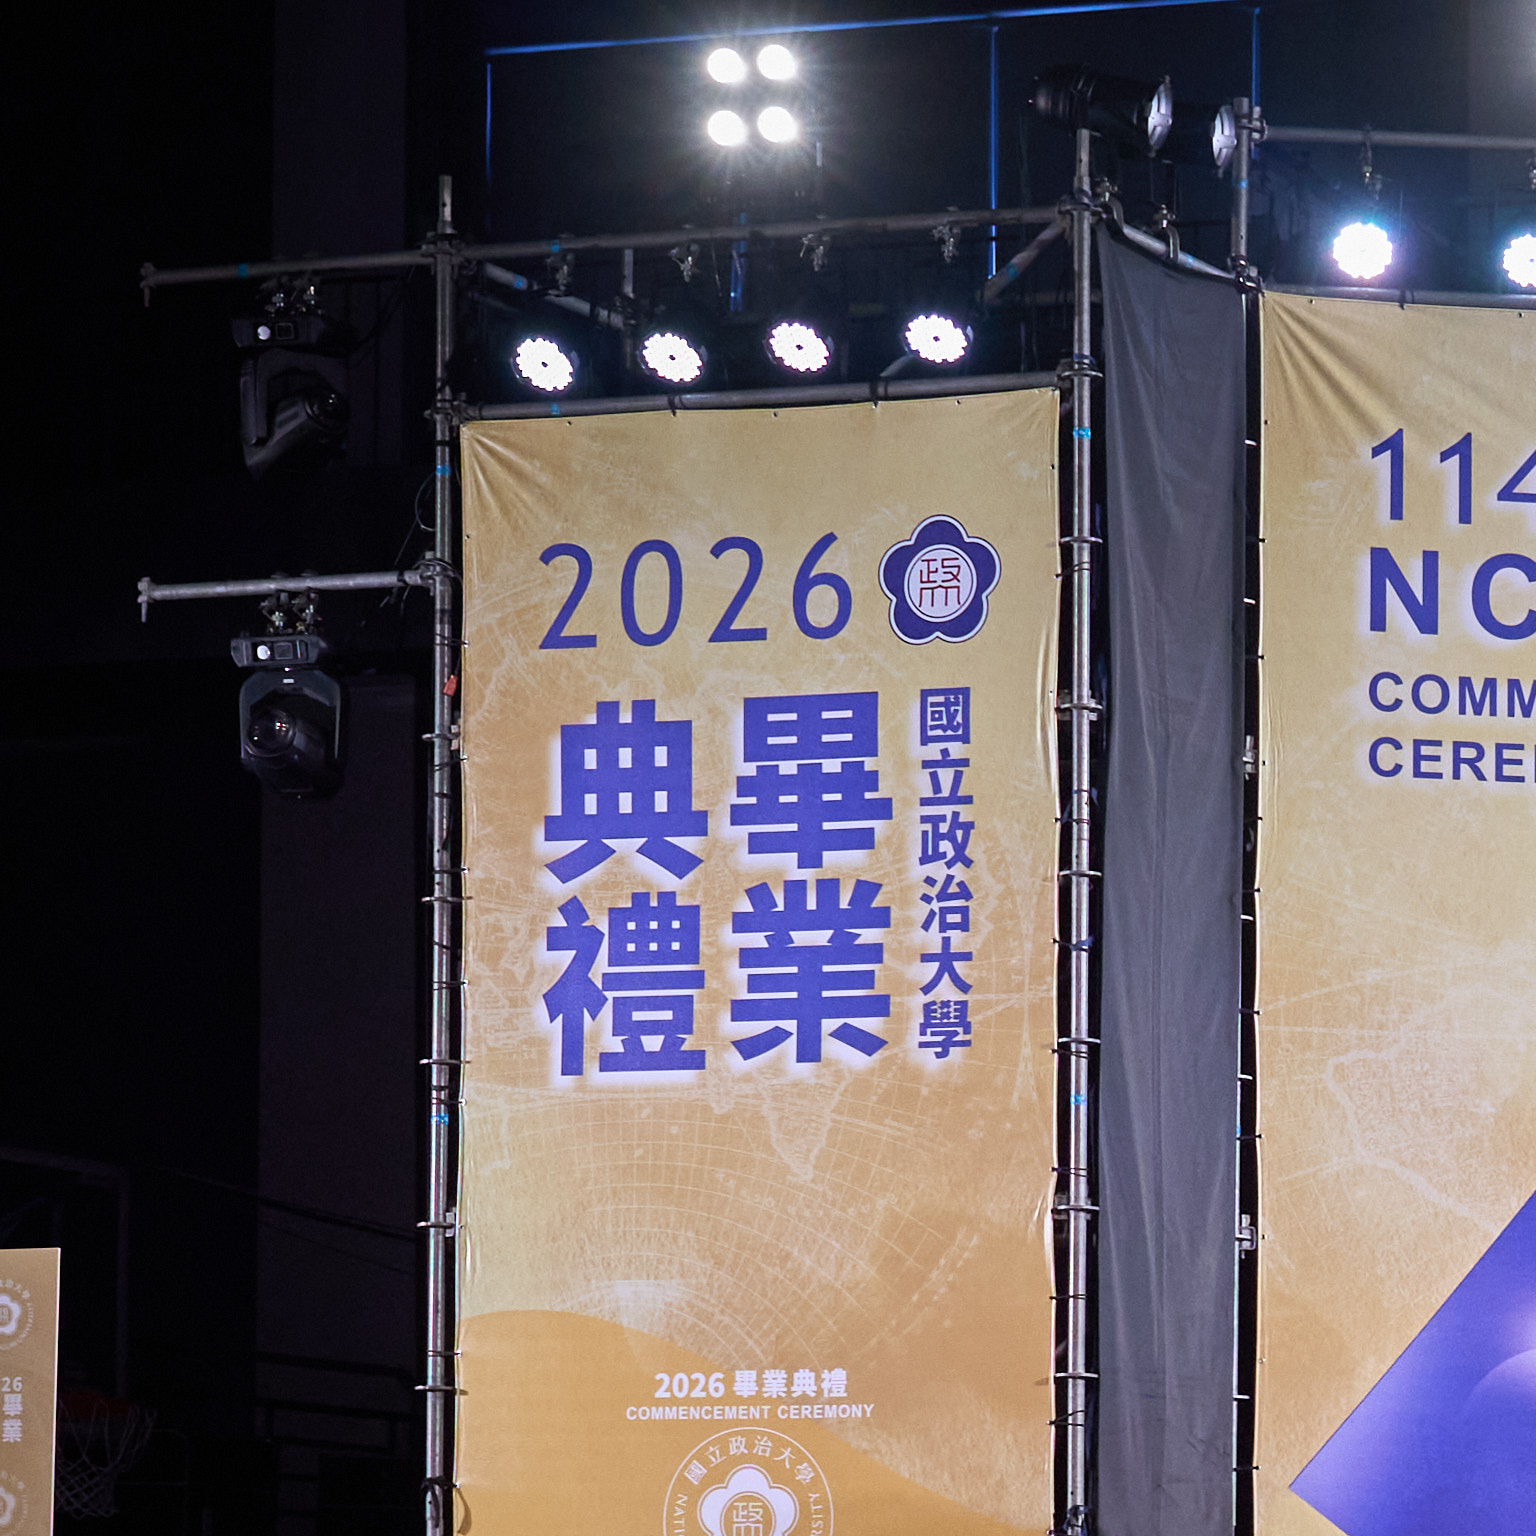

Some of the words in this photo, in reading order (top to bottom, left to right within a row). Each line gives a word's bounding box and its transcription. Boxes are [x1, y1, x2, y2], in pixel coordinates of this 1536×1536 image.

[538, 531, 853, 650] 2026
[542, 698, 709, 1077] 典禮
[729, 690, 894, 1064] 畢業
[918, 686, 975, 1060] 國立政治大學
[626, 1405, 772, 1421] COMMENCEMENT
[777, 1403, 875, 1420] CEREMONY
[654, 1371, 726, 1399] 2026
[732, 1368, 848, 1399] 畢業典禮
[683, 1434, 816, 1486] 國立政治大學
